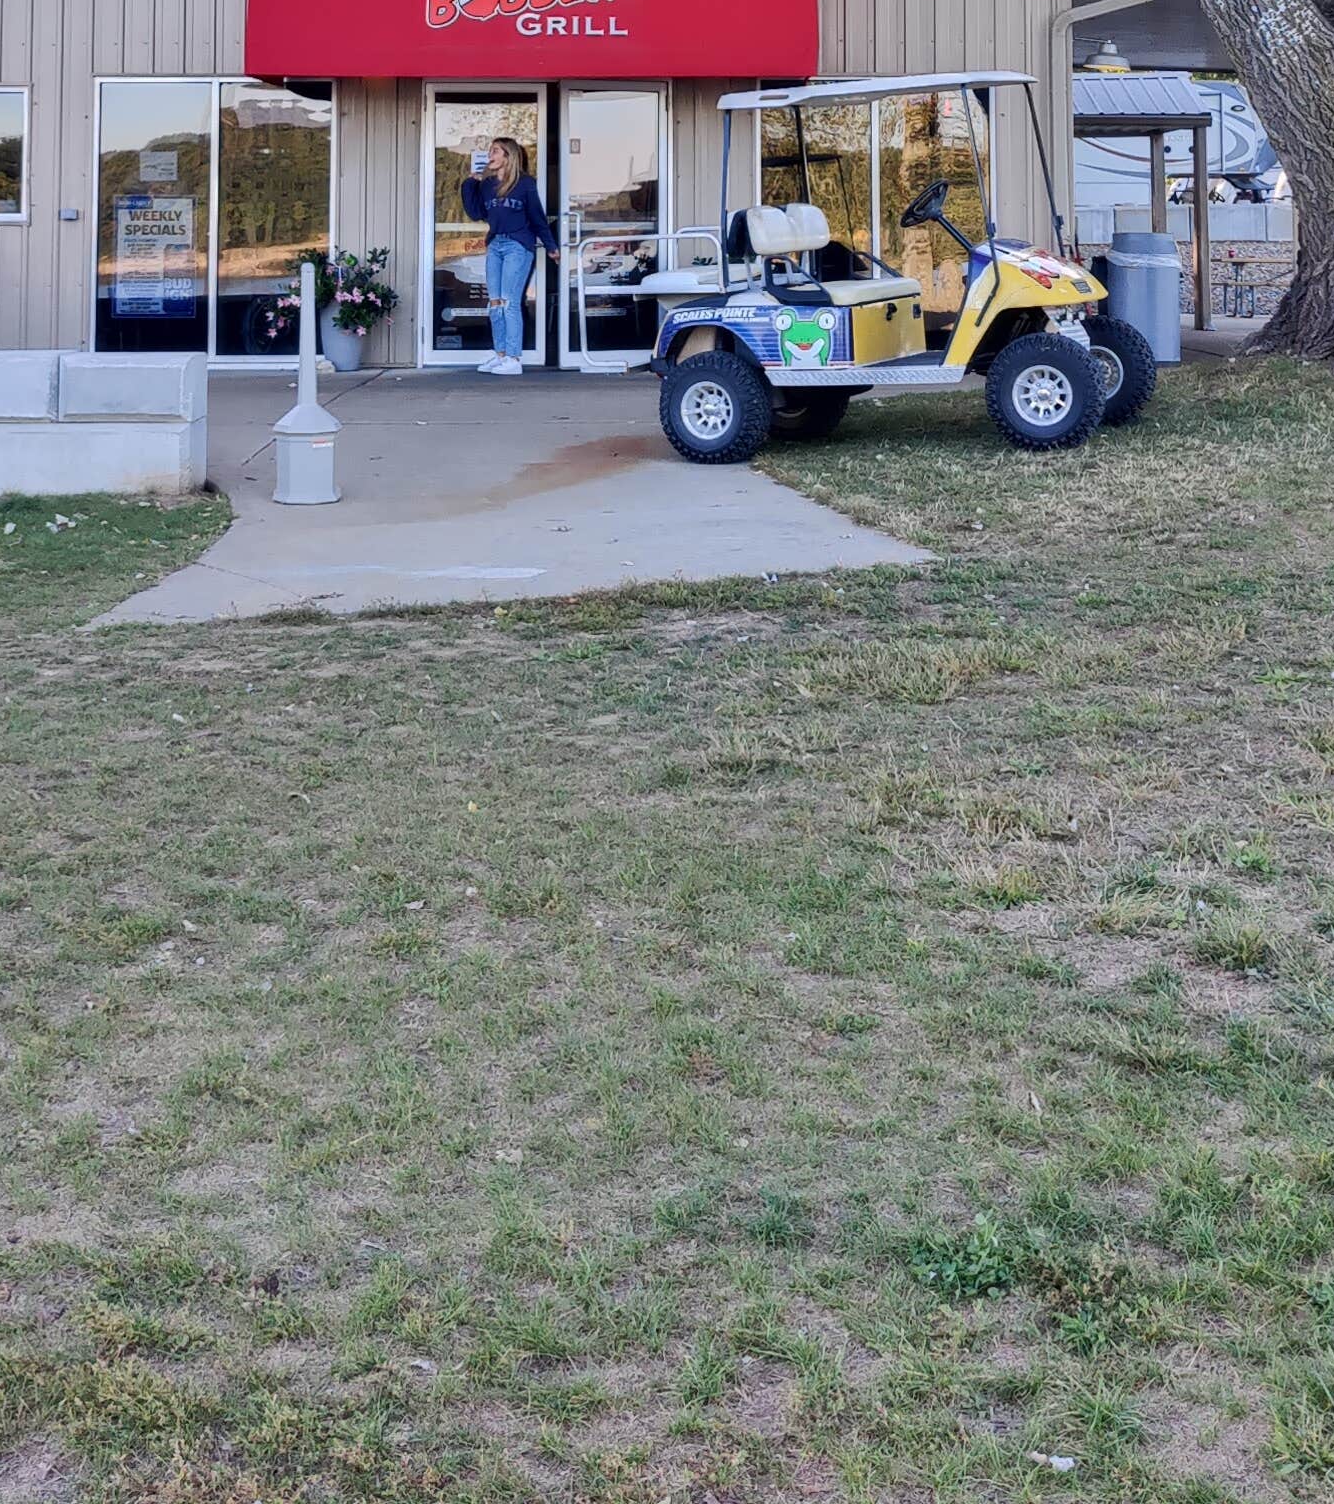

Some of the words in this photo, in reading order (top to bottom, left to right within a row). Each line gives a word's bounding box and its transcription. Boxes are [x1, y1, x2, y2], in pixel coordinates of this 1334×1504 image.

[516, 12, 629, 36] GRILL
[129, 210, 183, 222] WEEKLY
[124, 224, 186, 236] SPECIALS
[672, 308, 715, 325] SCALES
[714, 306, 757, 320] POINTE
